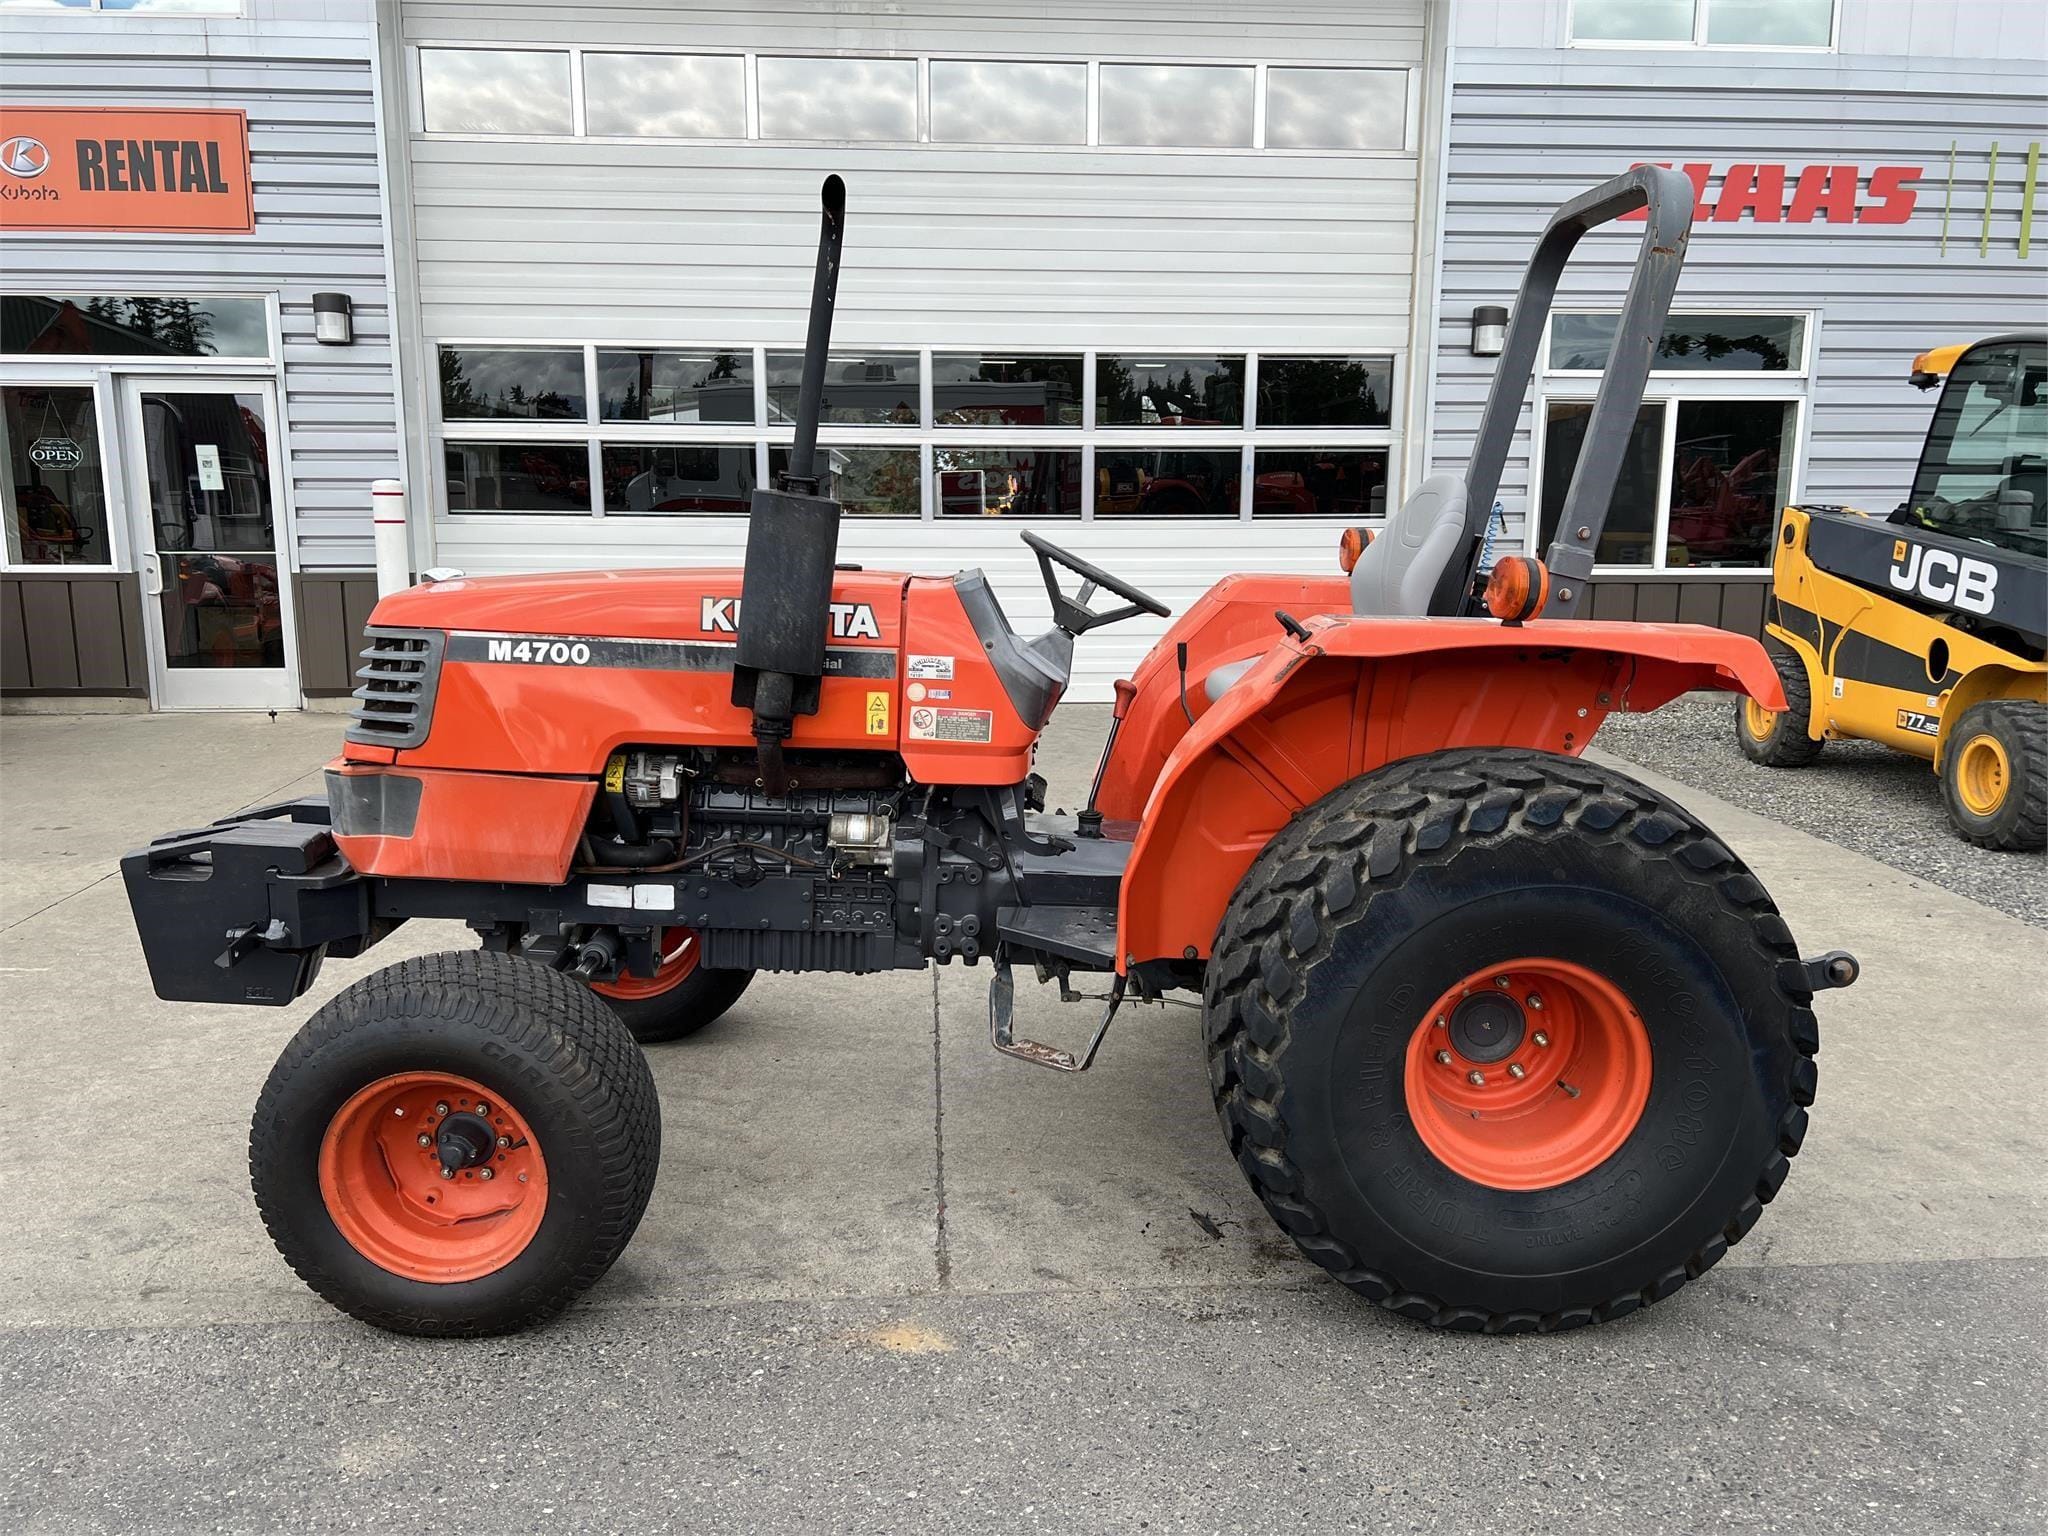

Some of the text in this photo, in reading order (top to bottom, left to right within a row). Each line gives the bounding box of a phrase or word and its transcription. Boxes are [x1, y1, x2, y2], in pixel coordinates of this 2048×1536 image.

[76, 139, 229, 193] RENTAL
[0, 184, 59, 200] Kubota
[1617, 163, 1923, 224] LAAS
[32, 449, 80, 460] OPEN
[1889, 543, 1998, 615] JCB
[702, 596, 880, 639] KTA
[488, 639, 590, 665] M4700
